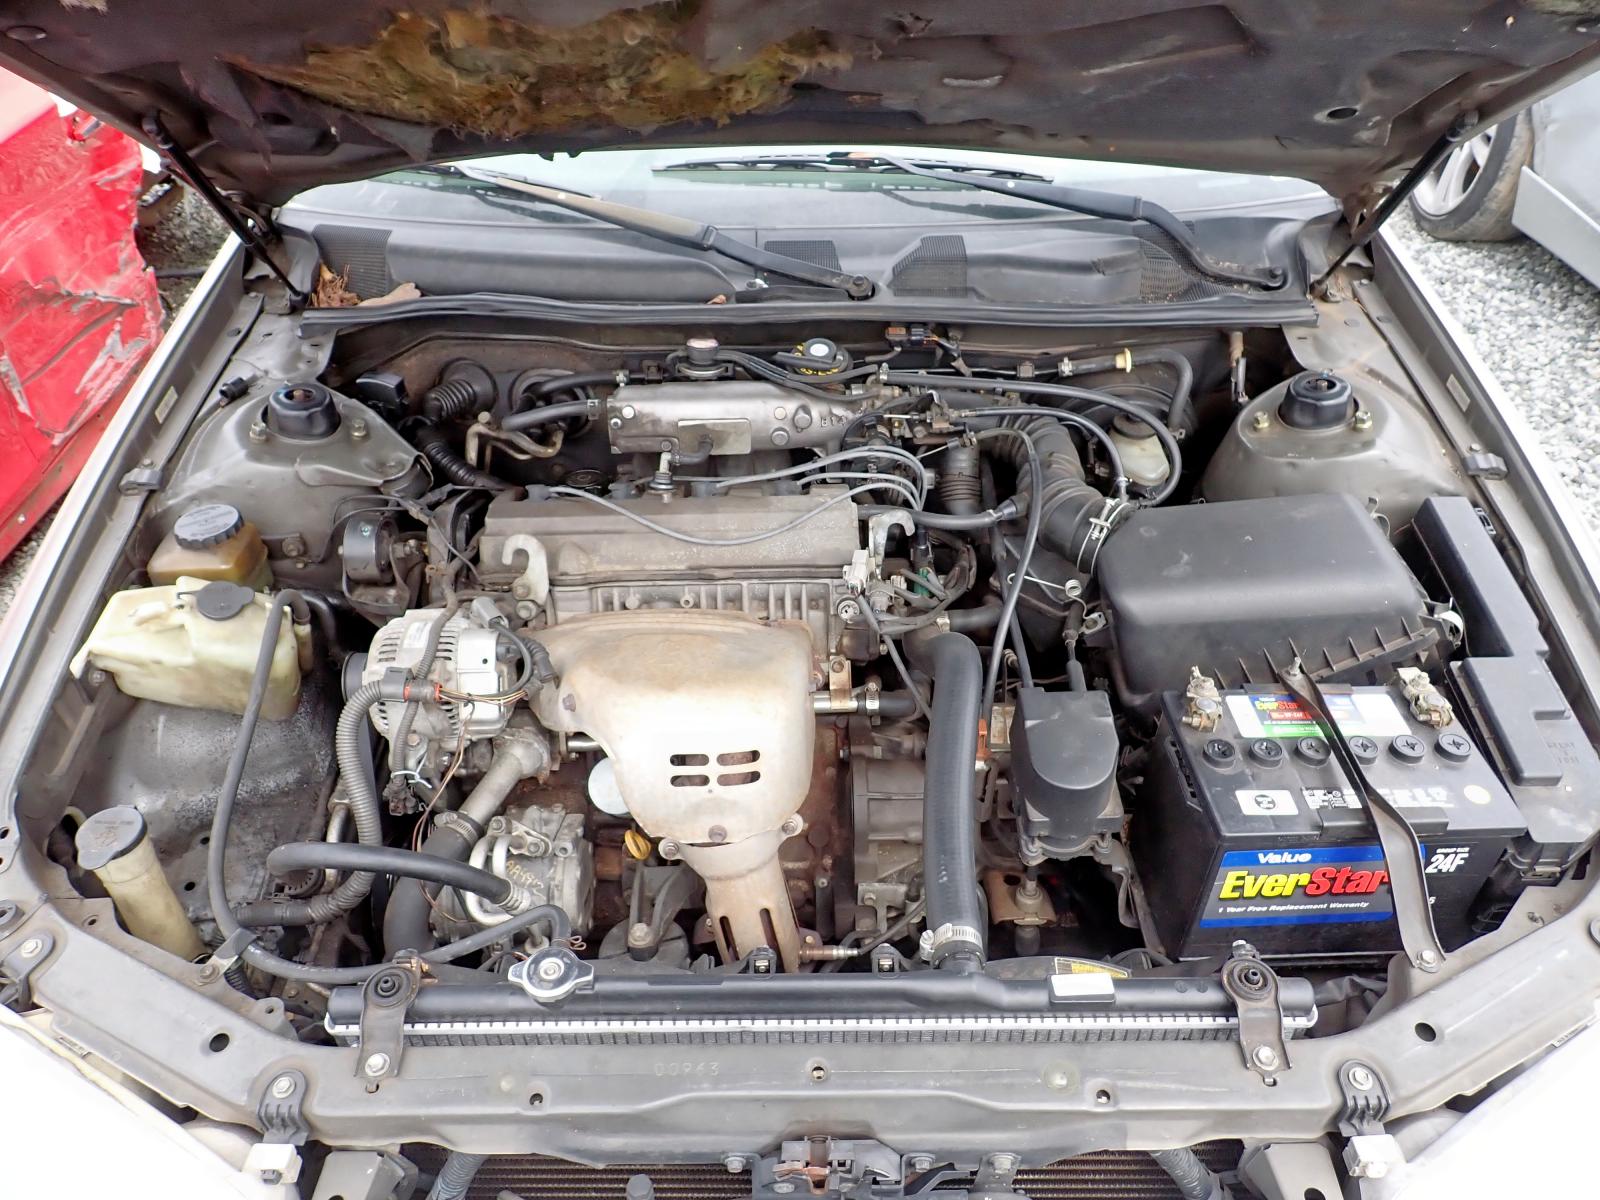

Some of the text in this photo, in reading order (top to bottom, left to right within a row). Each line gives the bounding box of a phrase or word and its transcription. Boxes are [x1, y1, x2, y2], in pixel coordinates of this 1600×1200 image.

[1257, 852, 1313, 865] Value
[1425, 853, 1470, 874] 24F
[1226, 906, 1247, 914] Year
[1247, 904, 1268, 913] Free
[1269, 902, 1328, 912] Replacement
[1329, 901, 1370, 911] Warranty
